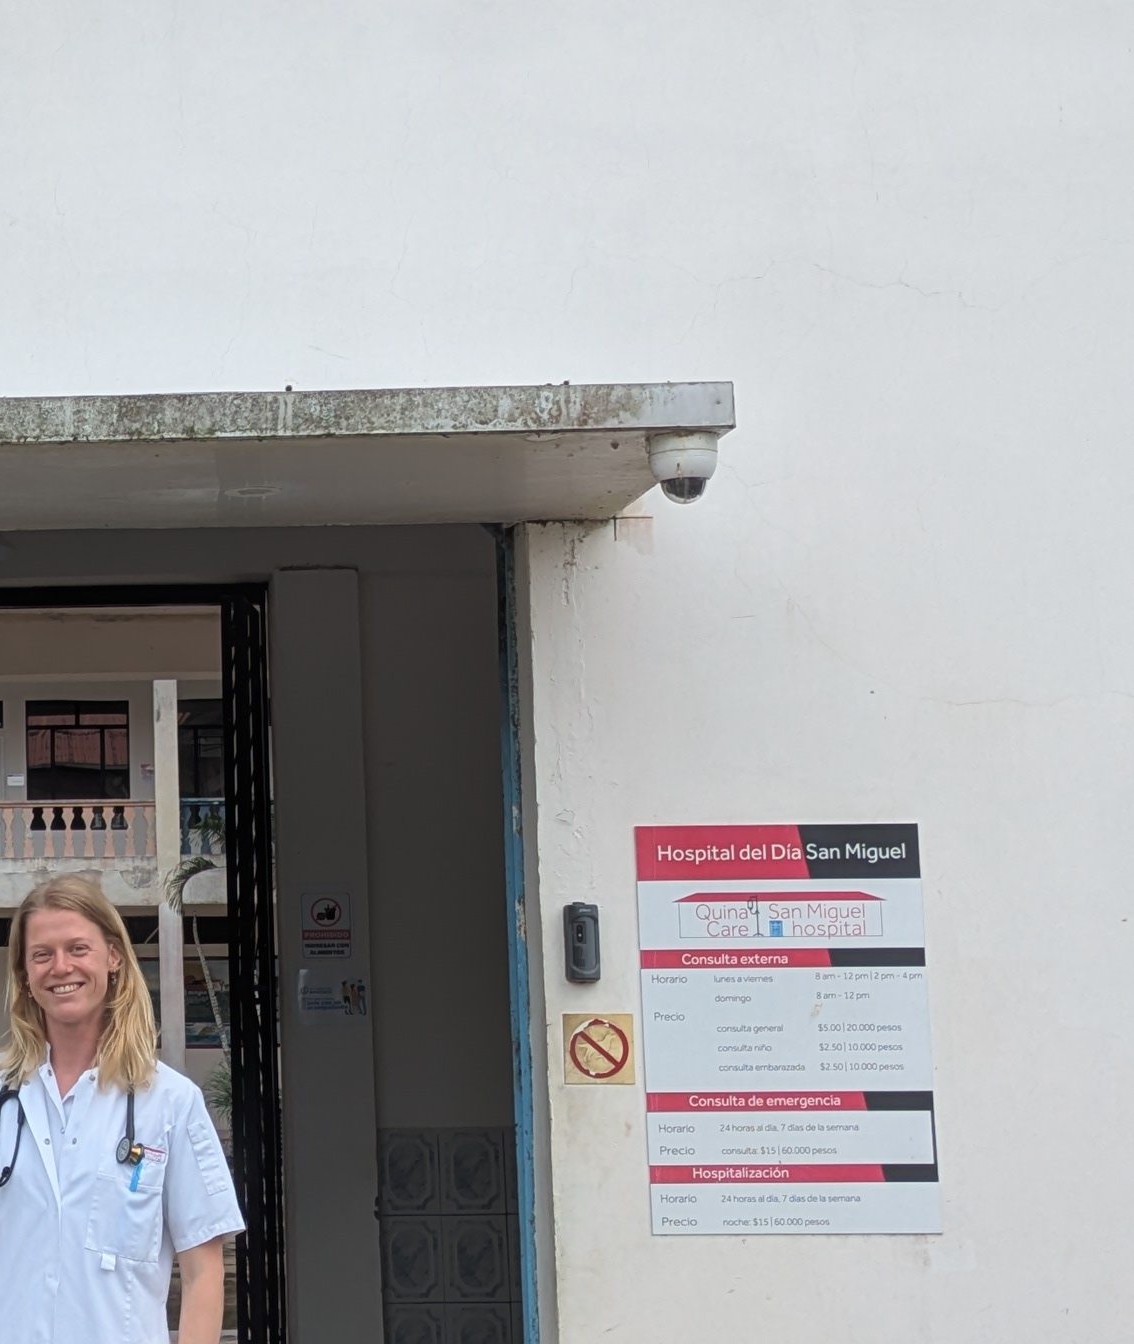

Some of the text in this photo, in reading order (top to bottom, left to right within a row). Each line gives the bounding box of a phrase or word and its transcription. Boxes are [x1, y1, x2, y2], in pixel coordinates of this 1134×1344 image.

[657, 842, 906, 865] Hospital del Día San Miguel
[695, 903, 749, 921] Quina
[768, 902, 866, 923] San Miguel
[706, 921, 749, 937] Care
[792, 920, 866, 940] hospital
[681, 953, 789, 965] Consulta externa
[651, 974, 688, 984] Horario
[713, 975, 736, 983] lunes
[743, 975, 773, 983] viernes
[815, 972, 820, 980] 8
[843, 972, 854, 980] 12
[881, 973, 895, 981] pm
[908, 973, 923, 981] pm
[714, 995, 752, 1004] domingo
[856, 993, 870, 1001] pm
[653, 1012, 686, 1022] Precio
[716, 1024, 752, 1033] consulta
[753, 1024, 784, 1034] general
[876, 1025, 902, 1033] pesos
[717, 1044, 753, 1052] consulta
[754, 1044, 772, 1052] niño
[878, 1044, 903, 1052] pesos
[719, 1063, 754, 1072] consulta
[755, 1063, 806, 1071] embarazada
[879, 1064, 904, 1072] pesos
[688, 1095, 841, 1109] Consulta de emergencia
[658, 1124, 695, 1133] Horario
[719, 1124, 731, 1132] 24
[732, 1124, 755, 1132] horas
[756, 1124, 764, 1132] al
[780, 1123, 786, 1132] 7
[787, 1124, 804, 1132] días
[805, 1124, 816, 1132] de
[817, 1124, 825, 1132] la
[659, 1146, 696, 1155] Precio
[721, 1146, 758, 1155] consulta:
[760, 1146, 777, 1155] $15
[812, 1147, 838, 1156] pesos
[692, 1167, 789, 1181] Hospitalización
[660, 1194, 697, 1204] Horario
[721, 1195, 732, 1203] 24
[733, 1195, 757, 1203] horas
[758, 1195, 765, 1203] al
[782, 1194, 787, 1203] 7
[807, 1194, 818, 1203] de
[819, 1194, 826, 1203] la
[661, 1217, 698, 1226] Precio
[722, 1218, 751, 1226] noche:
[753, 1217, 769, 1227] $15
[804, 1218, 830, 1227] pesos
